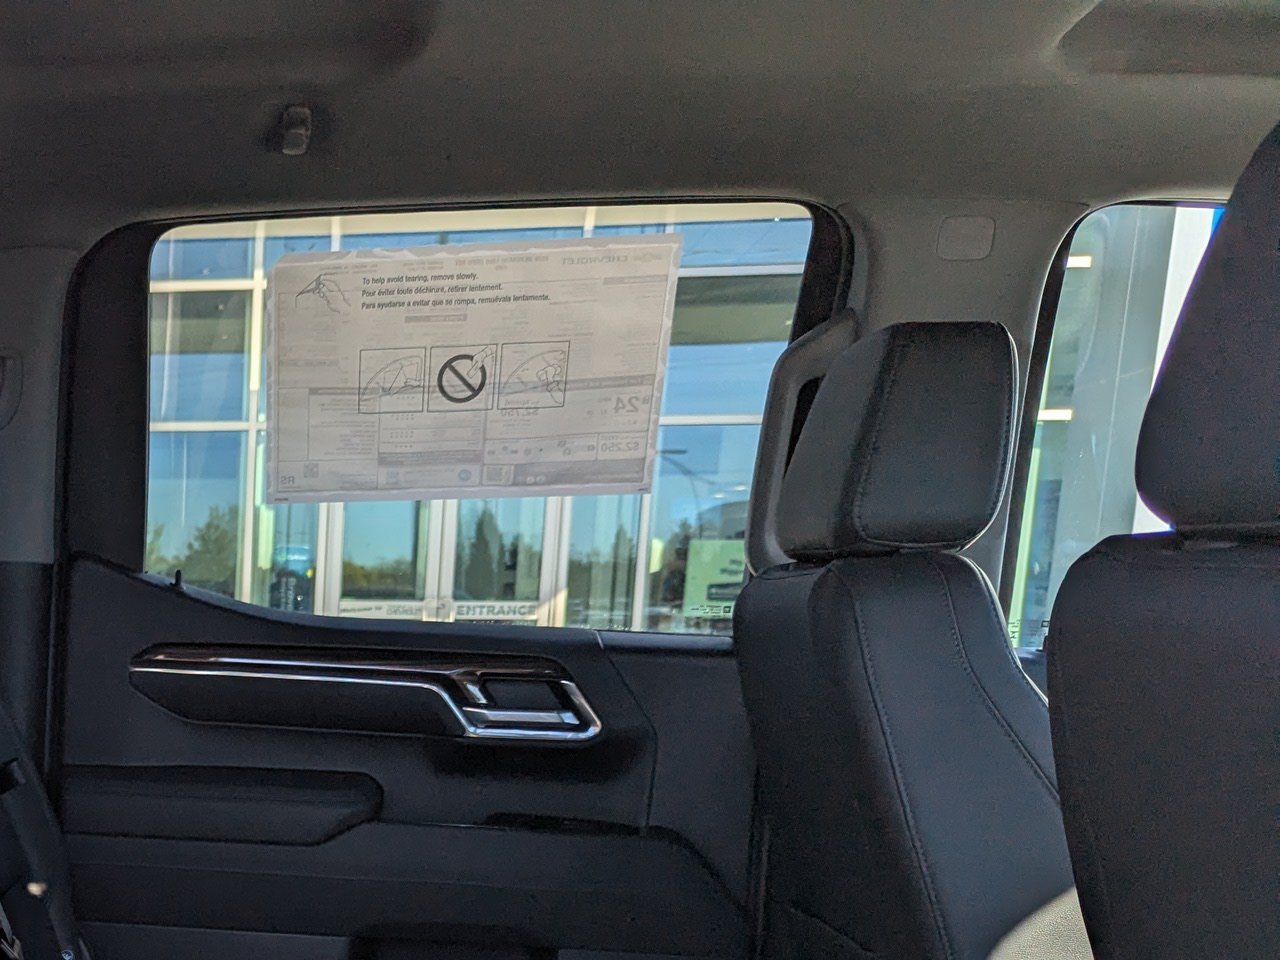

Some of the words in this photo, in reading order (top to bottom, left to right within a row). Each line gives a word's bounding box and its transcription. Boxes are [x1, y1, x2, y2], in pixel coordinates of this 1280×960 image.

[362, 277, 371, 285] To
[372, 276, 386, 285] help
[387, 275, 404, 283] avoid
[405, 275, 429, 283] tearing,
[431, 273, 455, 281] remove
[456, 272, 479, 280] slowly.
[361, 289, 376, 297] Pour
[378, 288, 396, 296] éviter
[397, 287, 413, 295] toute
[447, 285, 468, 293] retirer
[361, 302, 376, 310] Para
[377, 300, 406, 310] ayudarse
[412, 299, 431, 307] evitar
[432, 299, 444, 307] que
[456, 604, 537, 616] ENTRANCE
